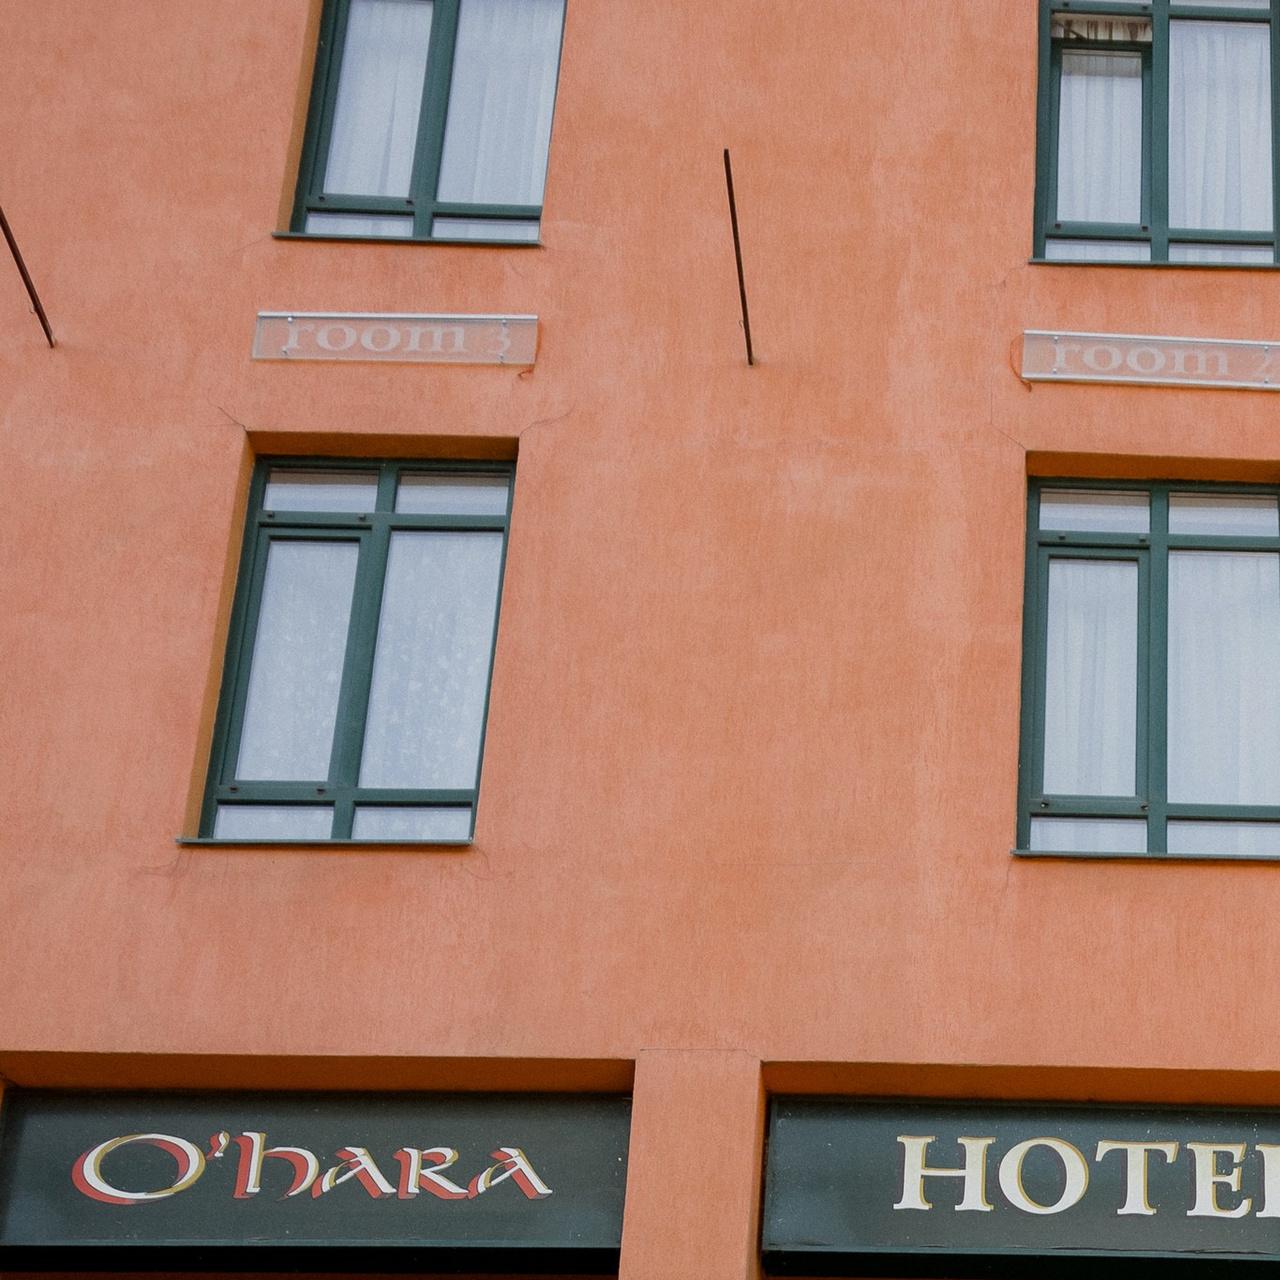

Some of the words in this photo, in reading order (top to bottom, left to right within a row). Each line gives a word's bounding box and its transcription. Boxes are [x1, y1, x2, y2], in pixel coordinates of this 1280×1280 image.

[282, 322, 465, 351] room
[495, 325, 511, 353] 3
[1053, 342, 1229, 376] room
[1250, 349, 1273, 376] 2
